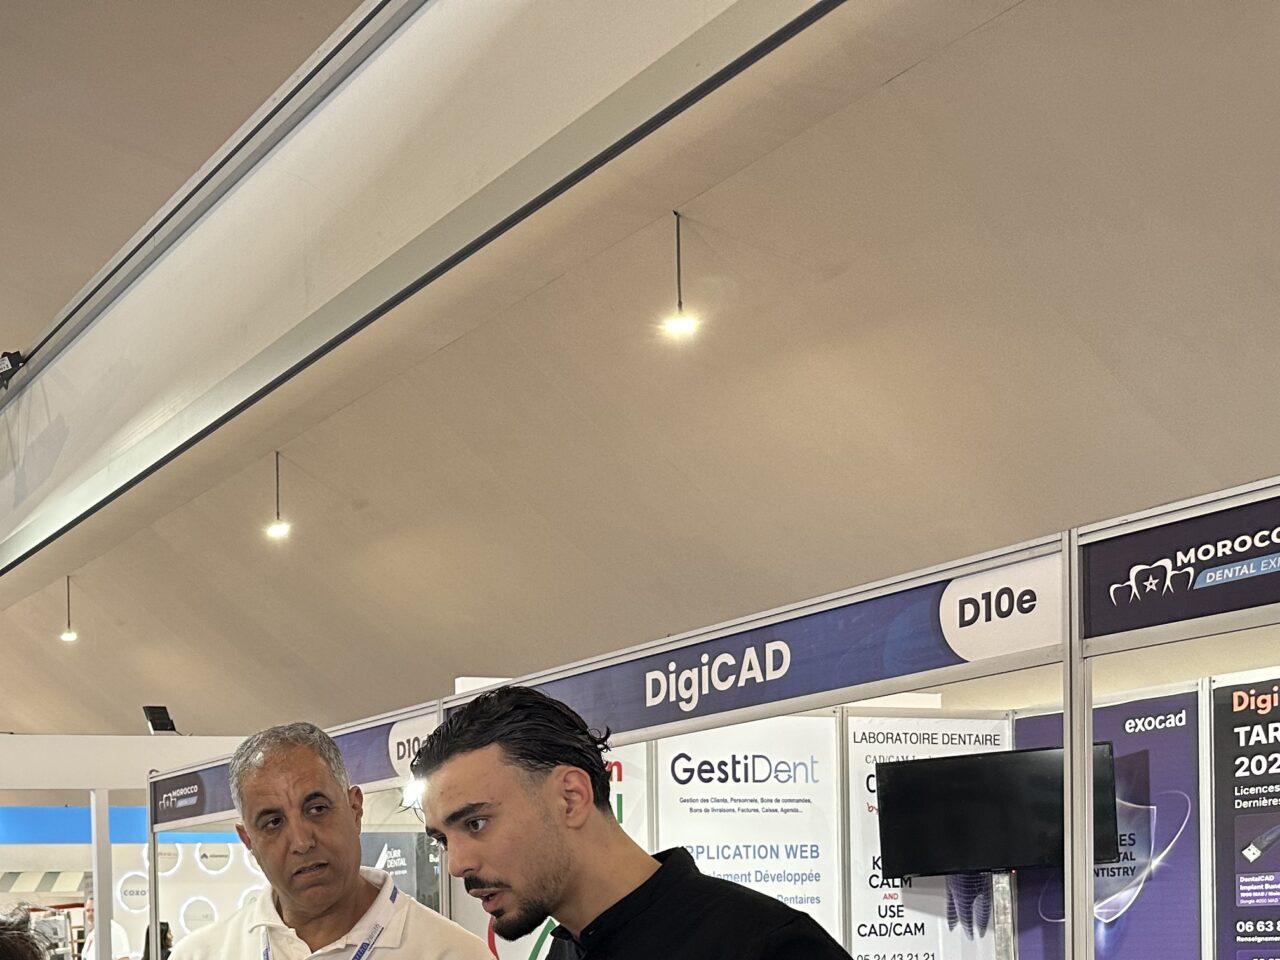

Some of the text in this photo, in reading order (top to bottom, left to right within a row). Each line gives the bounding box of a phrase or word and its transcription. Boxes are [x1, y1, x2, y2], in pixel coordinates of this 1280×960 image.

[1206, 563, 1256, 583] DENTAL
[958, 587, 1038, 628] D10e
[645, 640, 792, 712] DigiCAD
[1125, 709, 1187, 733] exocad
[853, 731, 1001, 746] LABORATOIRE DENTAIRE
[670, 752, 821, 785] GestiDent
[172, 785, 198, 797] MOROCCO
[689, 844, 820, 860] PPLICATION WEB
[387, 858, 407, 868] DENTAL
[754, 869, 821, 885] Développée
[869, 875, 912, 888] CALM
[882, 892, 899, 900] AND
[878, 904, 904, 918] USE
[857, 922, 925, 938] CAD/CAM
[1236, 921, 1274, 933] 06 63
